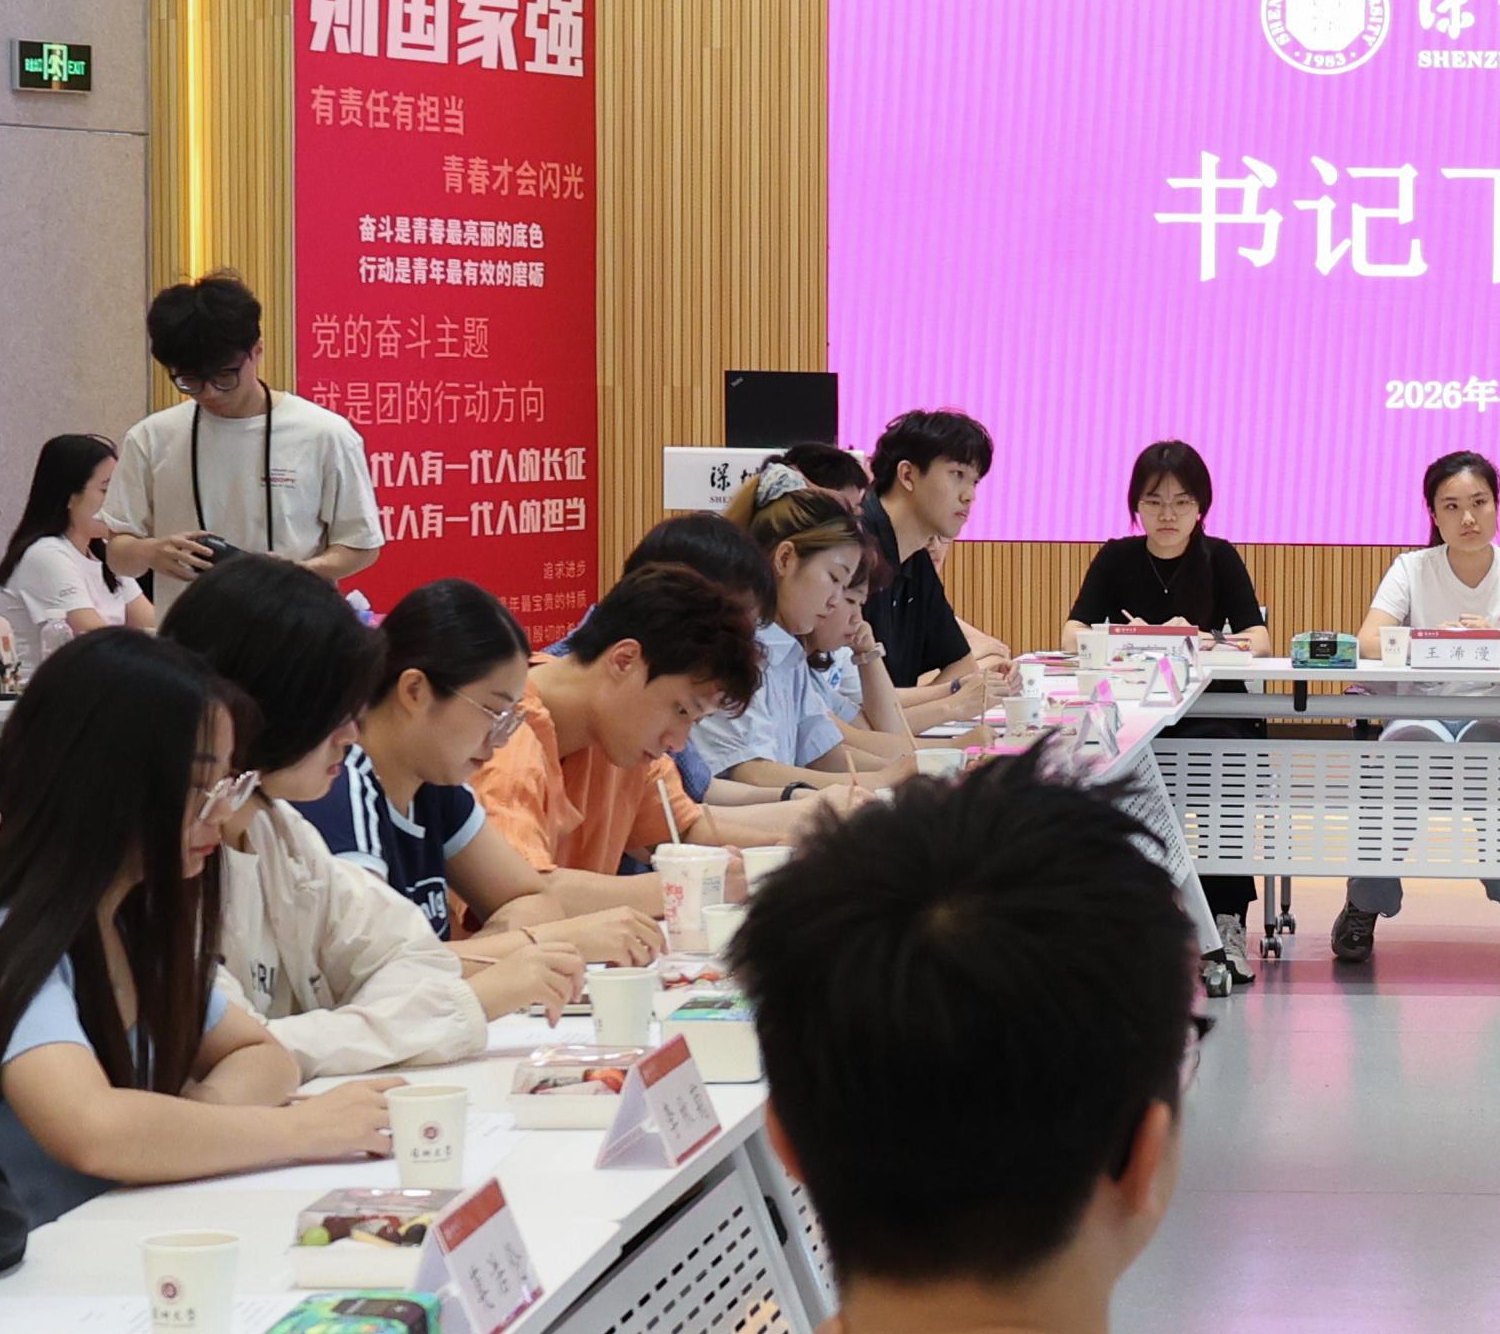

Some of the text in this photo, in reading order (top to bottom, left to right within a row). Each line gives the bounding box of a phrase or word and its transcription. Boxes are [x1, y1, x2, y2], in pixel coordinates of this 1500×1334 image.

[1303, 52, 1347, 68] 1983
[311, 84, 466, 136] 有责任有担当
[442, 154, 585, 200] 青春才会闪光
[359, 215, 545, 250] 奋斗是青春最亮丽的底色
[359, 255, 546, 288] 行动是青年最有效的磨砺
[311, 314, 490, 359] 党的奋斗主题
[311, 380, 545, 425] 就是团的行动方向
[543, 560, 587, 580] 追求进步
